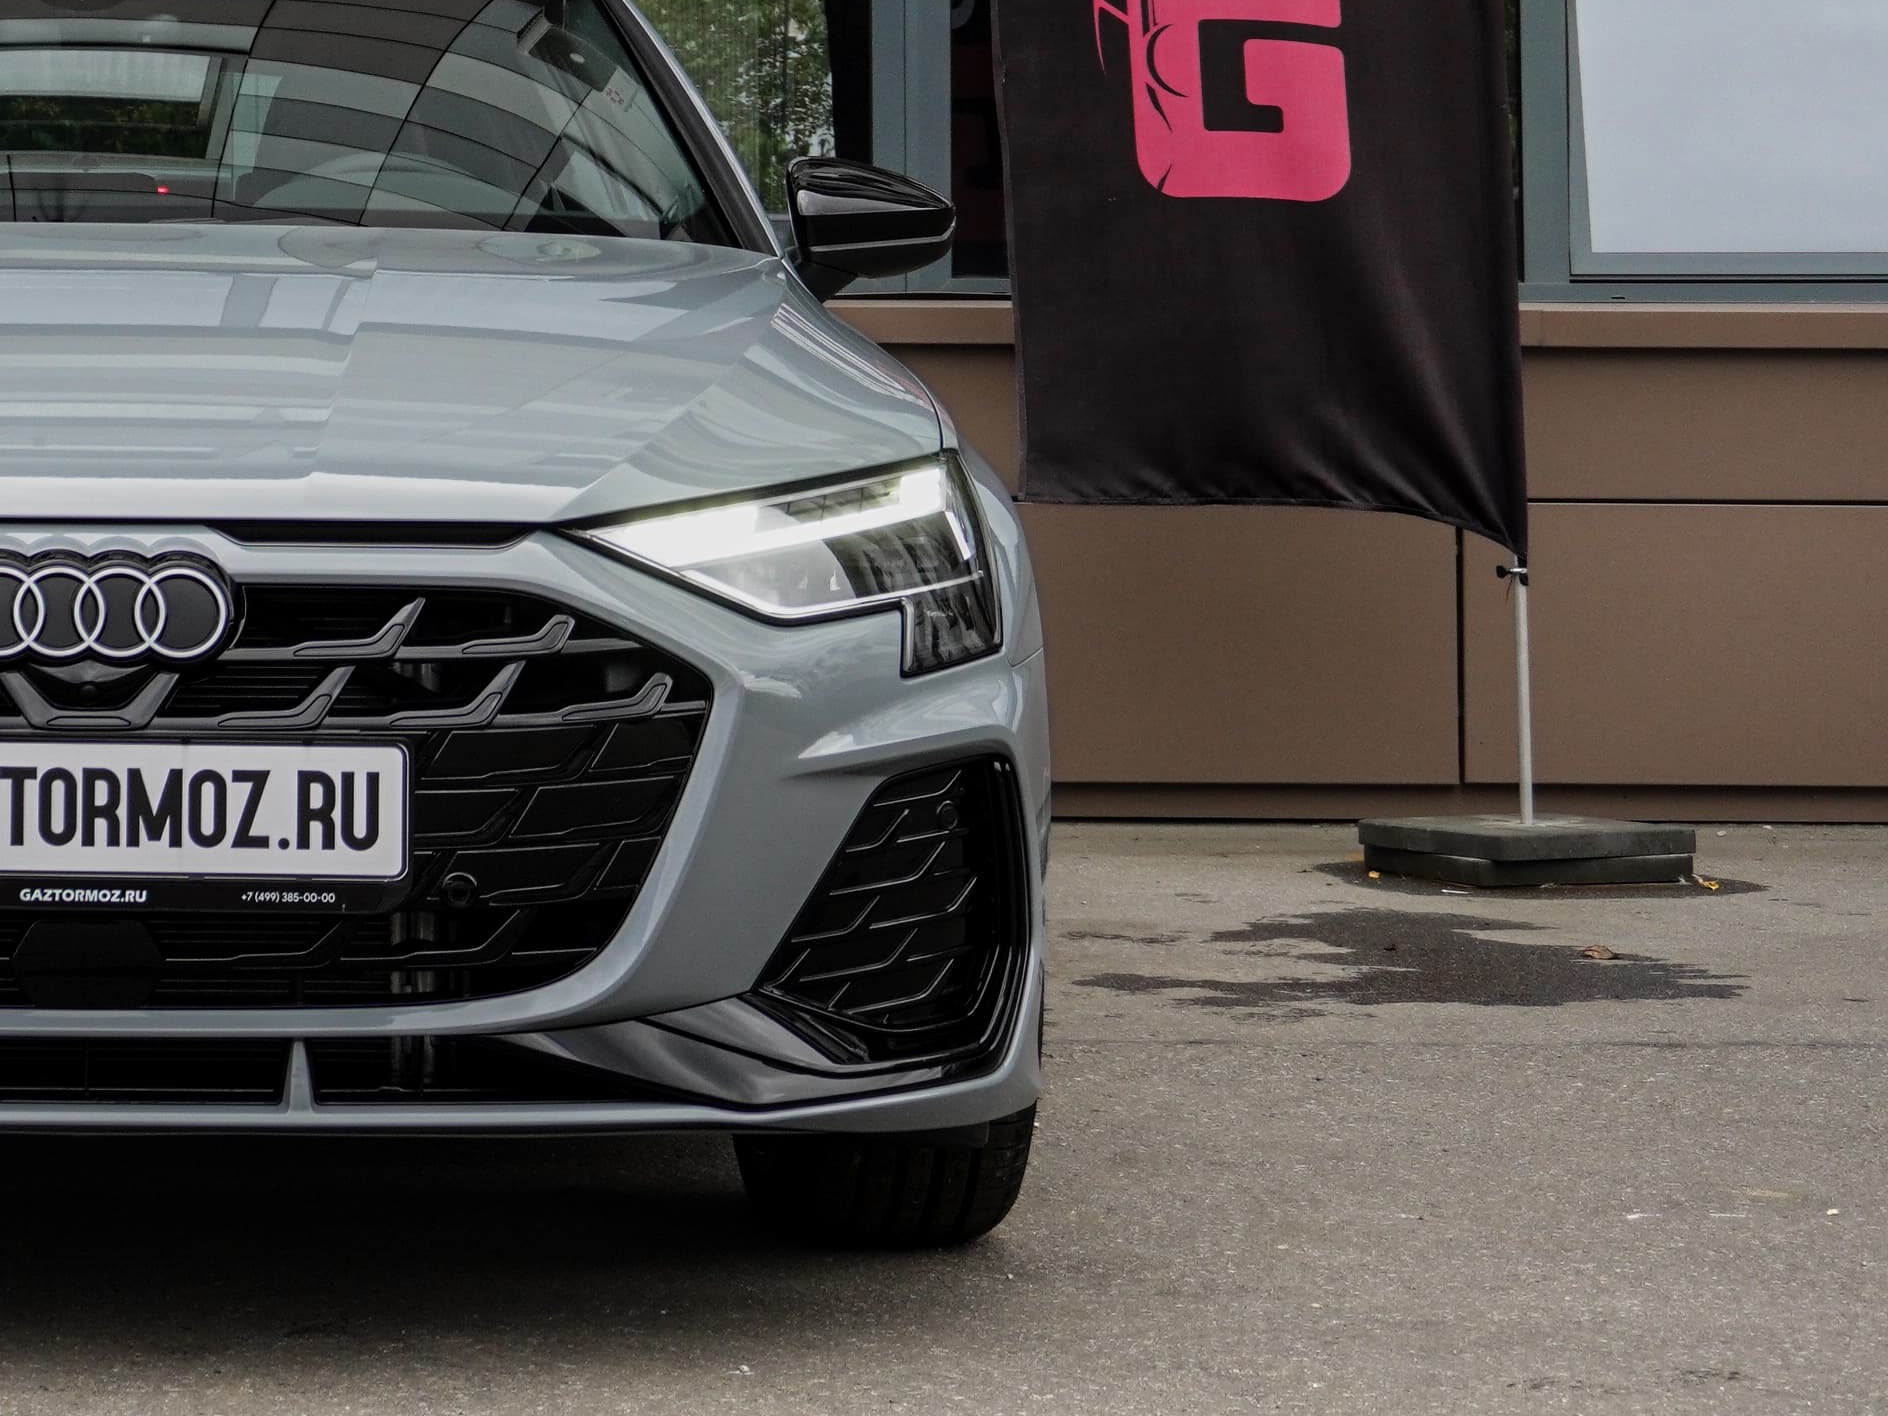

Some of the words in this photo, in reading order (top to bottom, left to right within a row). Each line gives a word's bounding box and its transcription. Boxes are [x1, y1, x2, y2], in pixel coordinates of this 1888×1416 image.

[19, 888, 147, 903] GAZTORMOZ.RU
[241, 892, 253, 902] +7
[254, 891, 280, 903] (499)
[281, 892, 336, 903] 385-00-00
